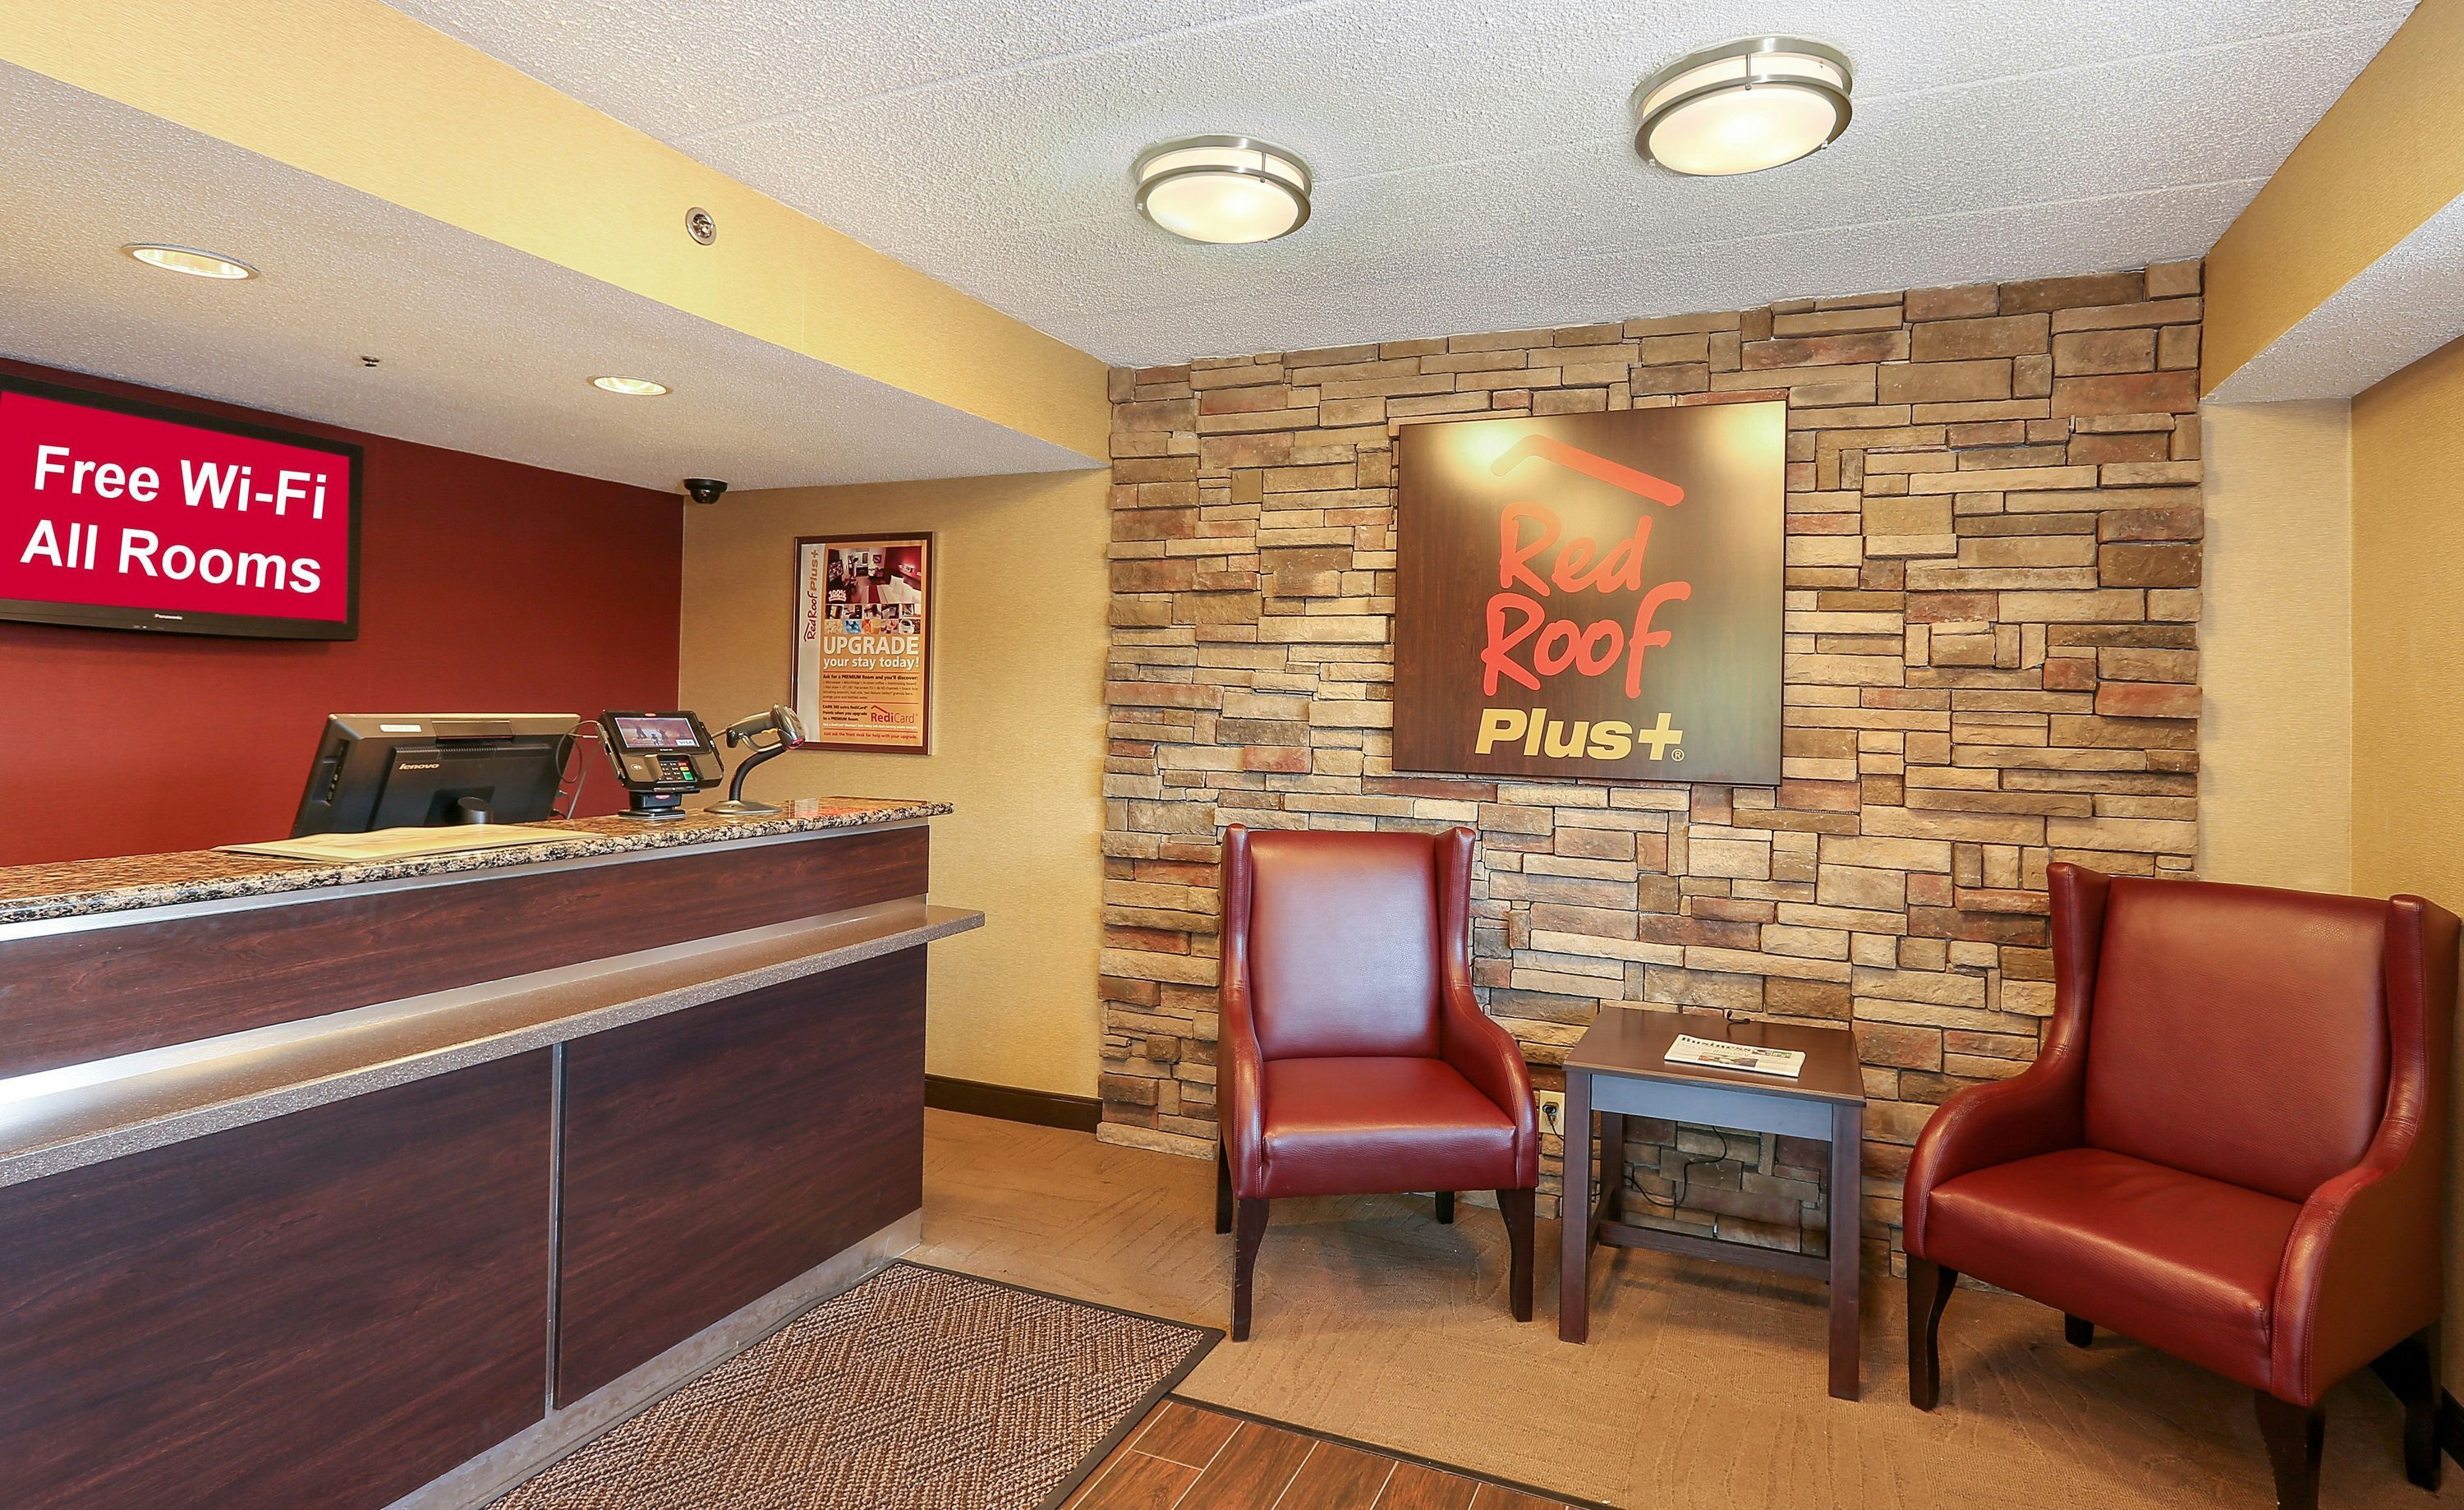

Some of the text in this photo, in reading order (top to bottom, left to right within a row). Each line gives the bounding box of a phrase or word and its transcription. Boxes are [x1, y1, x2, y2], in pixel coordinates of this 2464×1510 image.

[34, 444, 326, 519] Free Wi-Fi
[20, 519, 321, 593] All Rooms
[1500, 502, 1653, 596] Red
[807, 591, 818, 619] Roof
[823, 656, 919, 670] your stay today!
[824, 636, 919, 655] UPGRADE
[1481, 581, 1691, 698] Roof
[871, 712, 915, 724] RediCard
